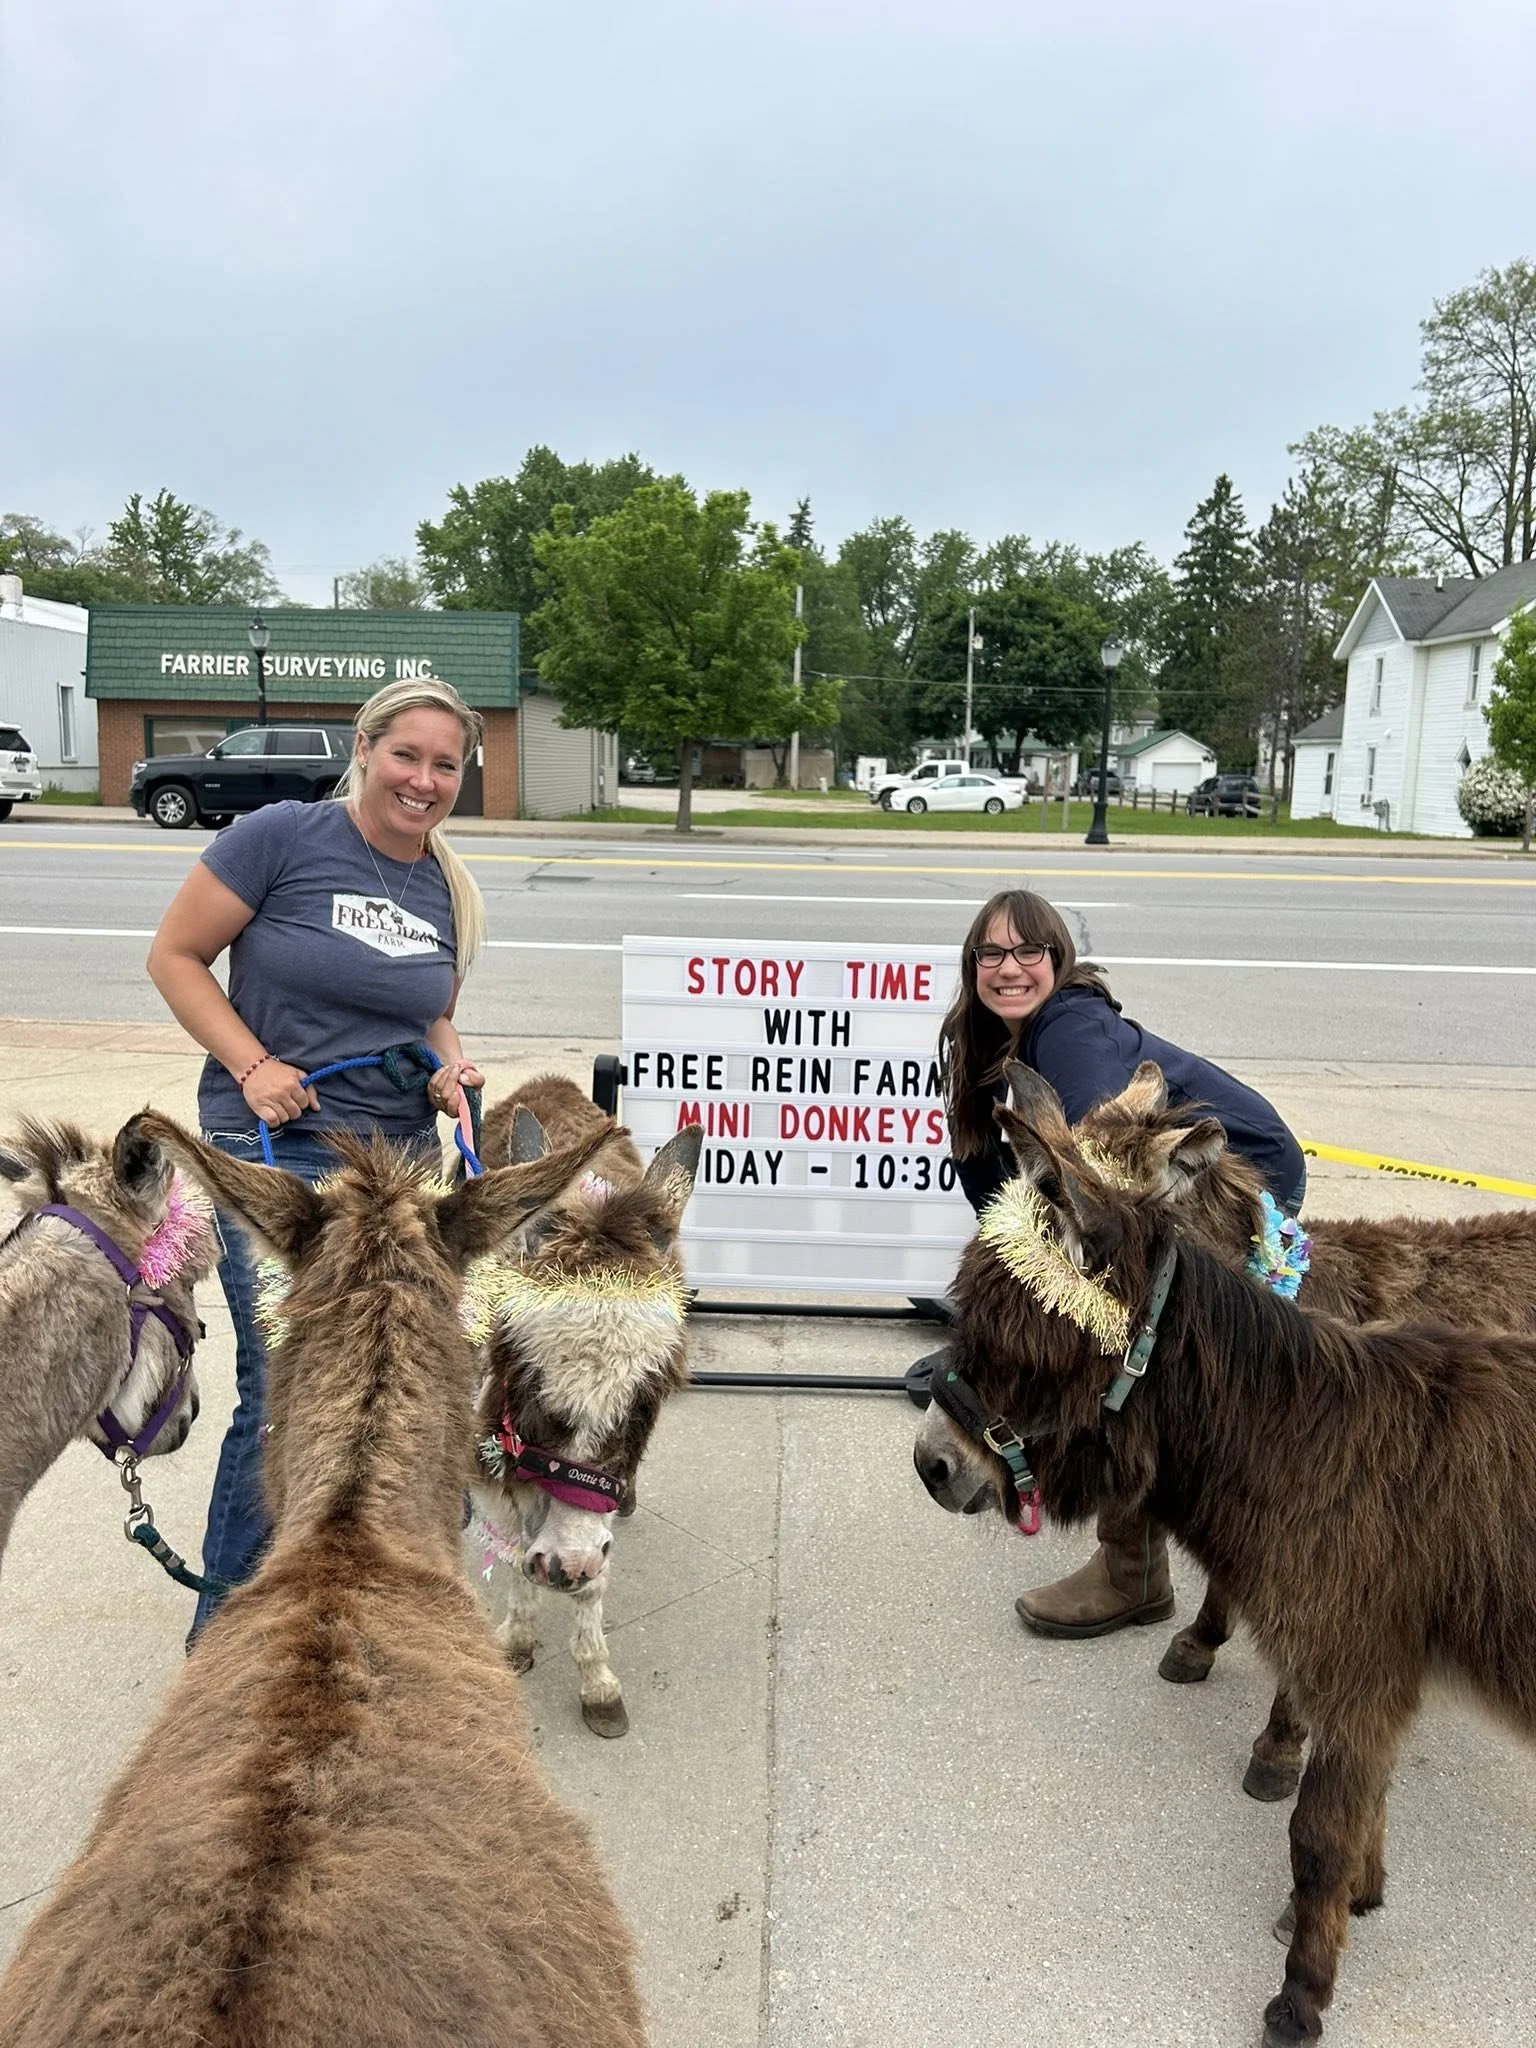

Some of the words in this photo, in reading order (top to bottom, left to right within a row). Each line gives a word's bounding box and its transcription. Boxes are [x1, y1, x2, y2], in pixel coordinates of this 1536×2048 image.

[161, 654, 250, 676] FARRIER
[262, 656, 386, 679] SURVEYING
[395, 659, 439, 680] INC.
[688, 957, 804, 997] STORY
[847, 962, 932, 1000] TIME
[764, 1008, 850, 1047] WITH
[634, 1053, 723, 1090] FREE
[752, 1057, 831, 1094] REIN
[677, 1101, 750, 1138] MINI
[780, 1104, 944, 1144] DONKEYS
[655, 1147, 783, 1185] IDAY
[855, 1154, 956, 1191] 10:30
[568, 1468, 598, 1484] Dottie
